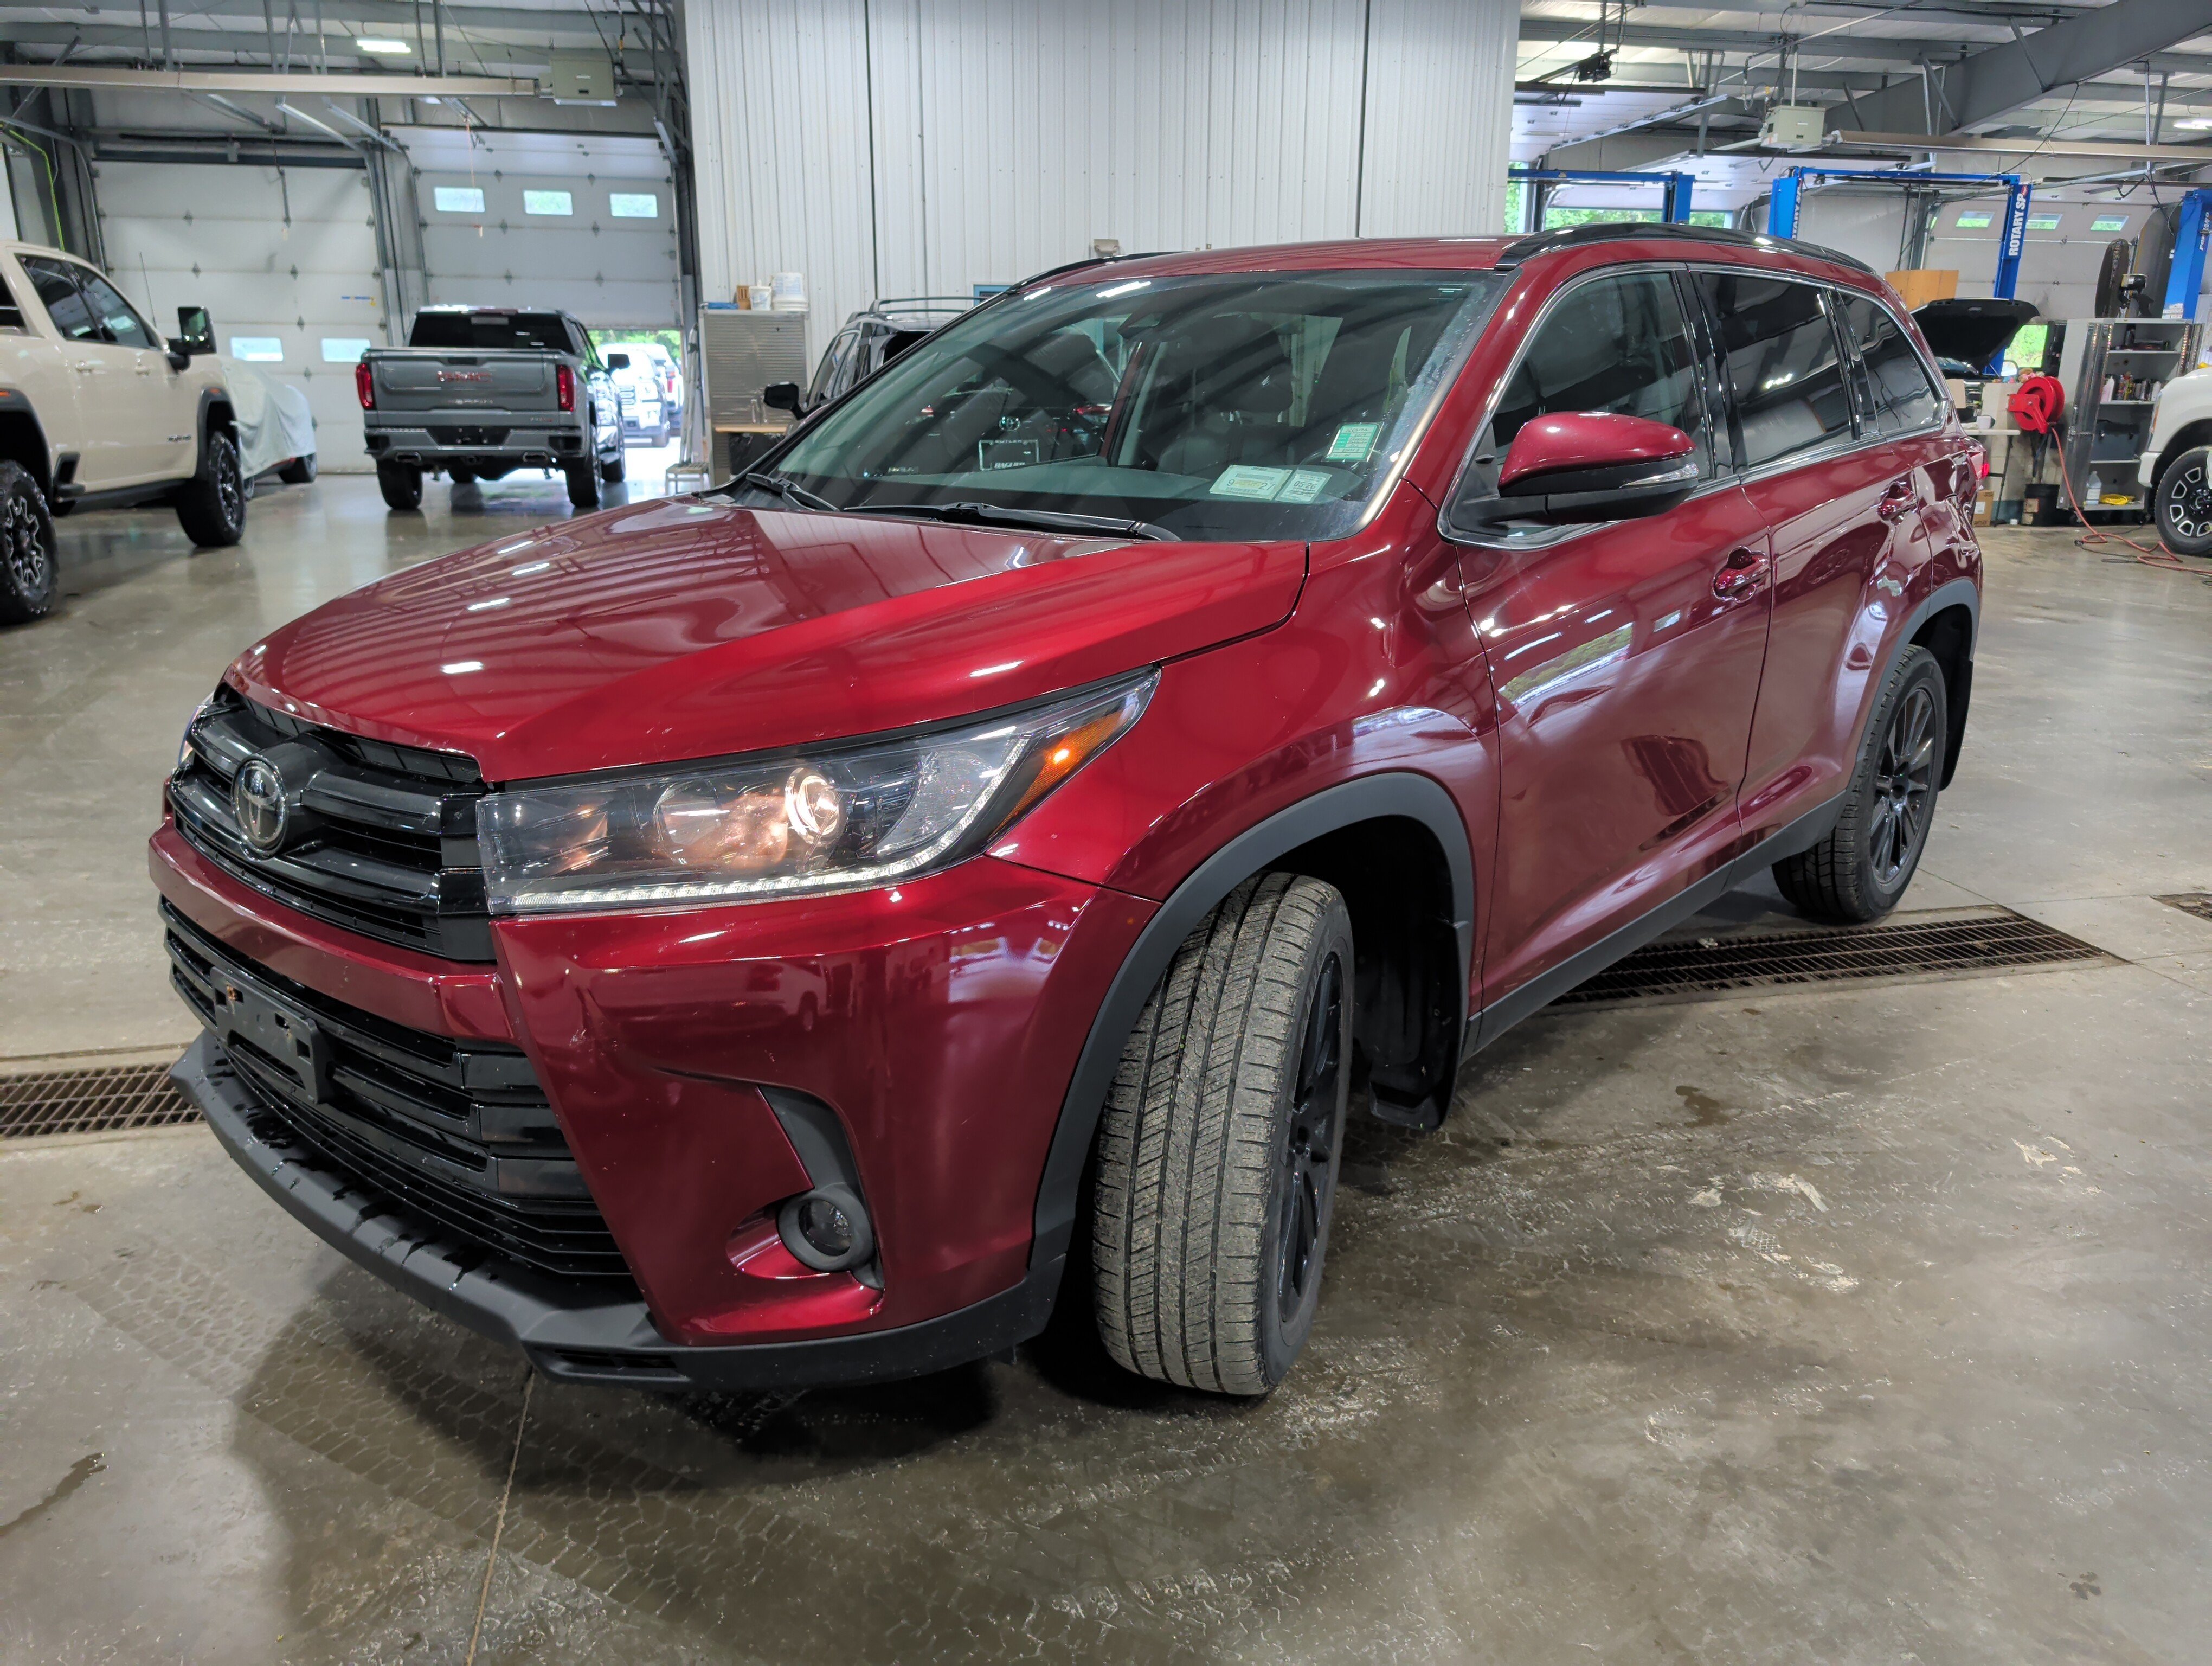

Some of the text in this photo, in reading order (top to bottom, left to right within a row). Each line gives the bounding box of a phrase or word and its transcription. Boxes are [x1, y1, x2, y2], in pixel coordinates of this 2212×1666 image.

[2015, 193, 2027, 210] SP
[2008, 210, 2024, 256] ROTARY
[1258, 482, 1276, 491] 27
